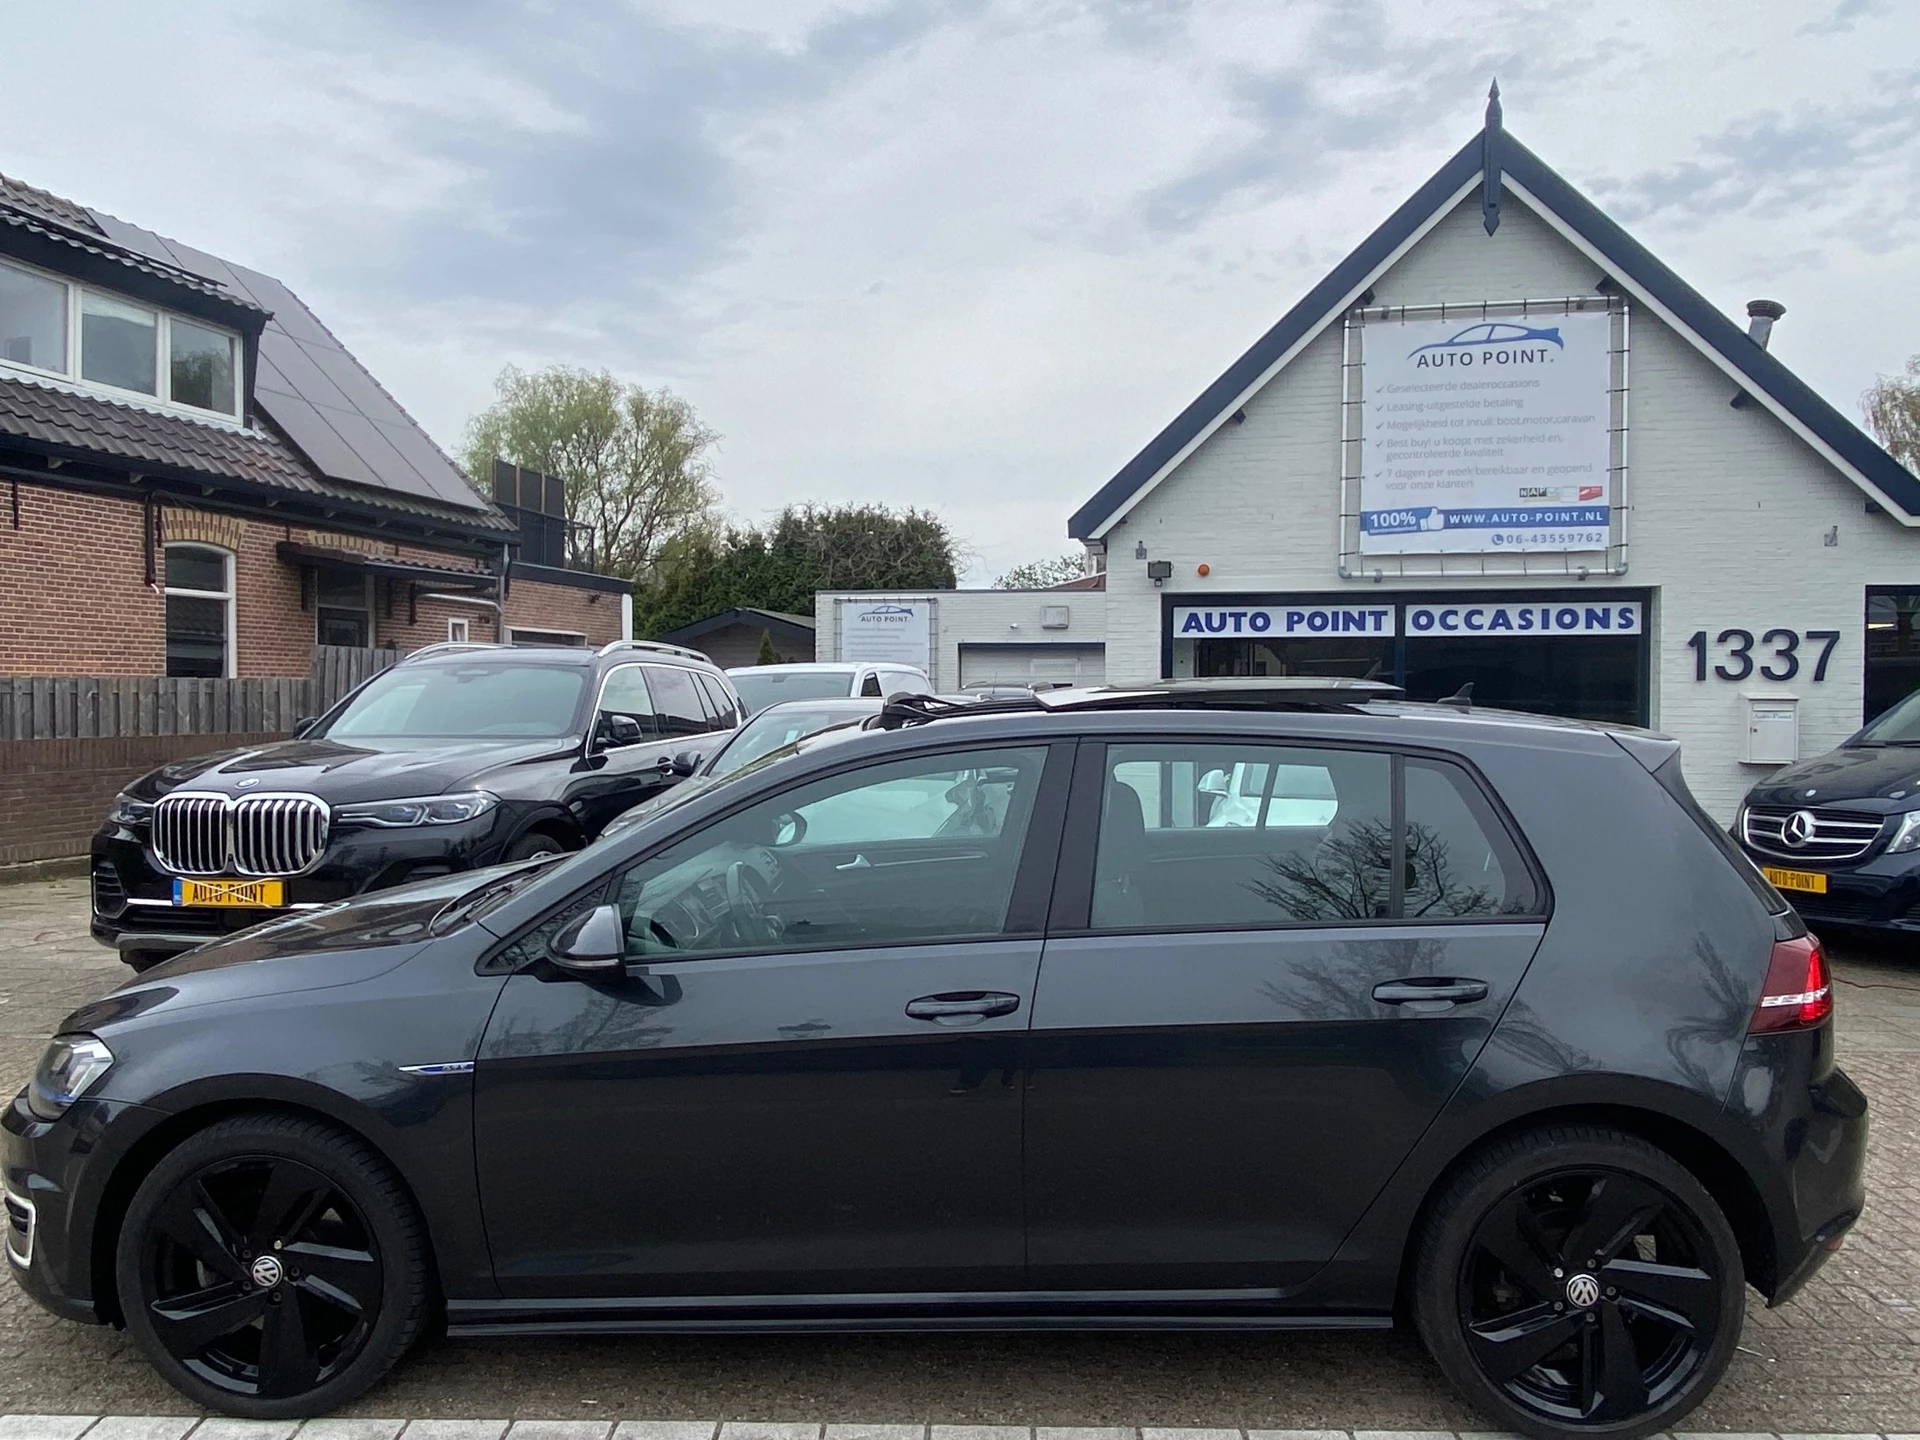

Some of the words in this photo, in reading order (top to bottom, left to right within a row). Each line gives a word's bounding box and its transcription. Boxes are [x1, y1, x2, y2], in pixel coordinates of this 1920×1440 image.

[1416, 352, 1473, 368] AUTO
[1387, 382, 1457, 394] Geselecteerde
[1460, 379, 1540, 391] dealeroccasions
[1387, 400, 1481, 412] Leasing-uitgestelde
[1484, 397, 1524, 409] betaling
[1387, 418, 1448, 431] Mogelijkheid
[1450, 418, 1464, 428] tot
[1387, 439, 1408, 449] Best
[1443, 436, 1471, 448] koopt
[1474, 436, 1493, 446] met
[1496, 433, 1545, 444] zekerheid
[1386, 448, 1461, 462] gecontroleerde
[1463, 447, 1504, 457] kwaliteit
[1387, 469, 1392, 478] 7
[1395, 468, 1425, 480] dagen
[1428, 468, 1444, 479] per
[1447, 467, 1473, 476] week
[1475, 465, 1529, 476] bereikbaar
[1531, 466, 1543, 475] en
[1546, 463, 1593, 476] geopend
[1385, 481, 1408, 490] voor
[1410, 480, 1435, 490] onze
[1436, 479, 1474, 489] klanten
[1519, 487, 1547, 498] NAP
[1370, 511, 1416, 528] 100%
[1449, 511, 1603, 524] WWW.AUTO-POINT.NL
[1506, 532, 1602, 544] 06-43559762
[1181, 611, 1271, 633] AUTO
[1286, 610, 1388, 632] POINT
[1411, 608, 1635, 631] OCCASIONS
[1687, 628, 1840, 682] 1337
[192, 882, 223, 902] AUTO
[227, 883, 265, 903] POINT
